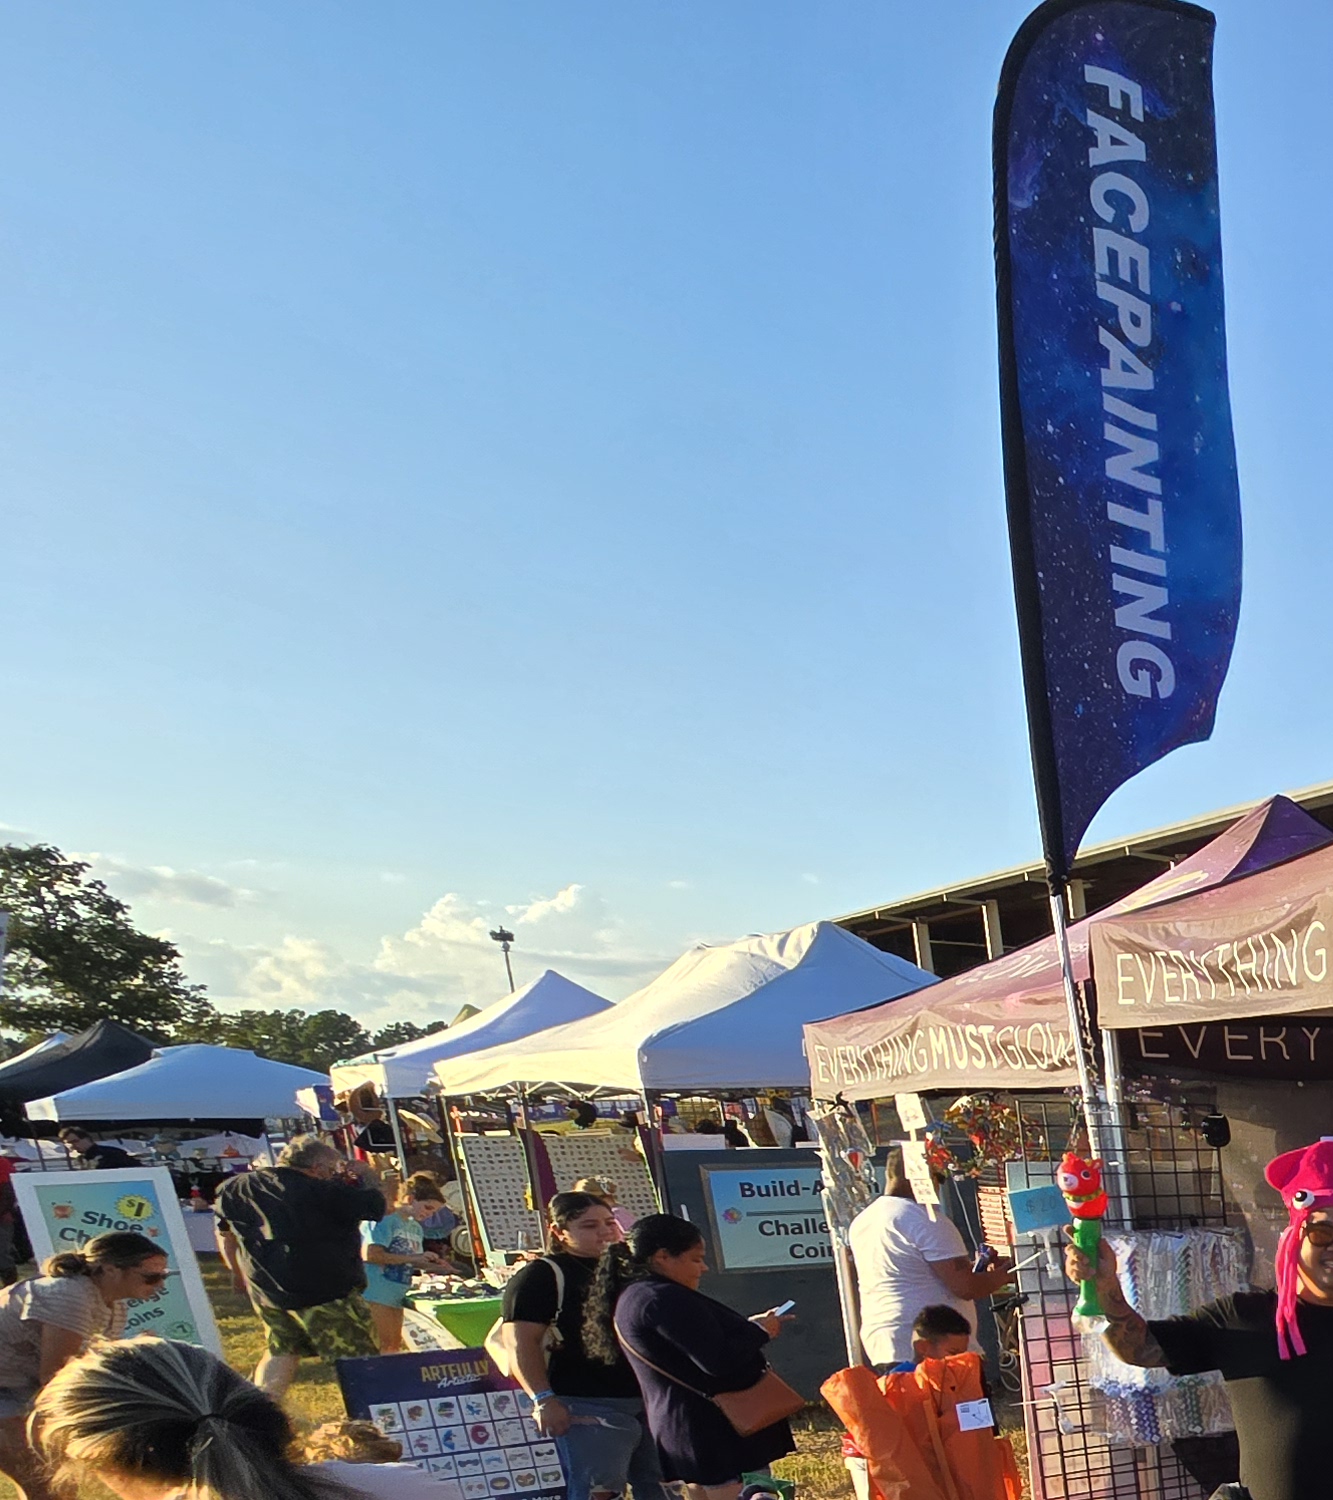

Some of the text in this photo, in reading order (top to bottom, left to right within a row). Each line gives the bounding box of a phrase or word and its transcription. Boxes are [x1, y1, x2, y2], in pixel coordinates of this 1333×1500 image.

[1083, 62, 1177, 701] FACEPAINTING
[1116, 918, 1328, 1005] EVERYTHING
[814, 1021, 1077, 1084] EVERYTHING MUST GLOW
[126, 1198, 146, 1218] $1
[81, 1211, 144, 1233] Shoe
[758, 1218, 831, 1237] Challe
[124, 1306, 165, 1331] oins
[420, 1360, 489, 1382] ARTFULLY
